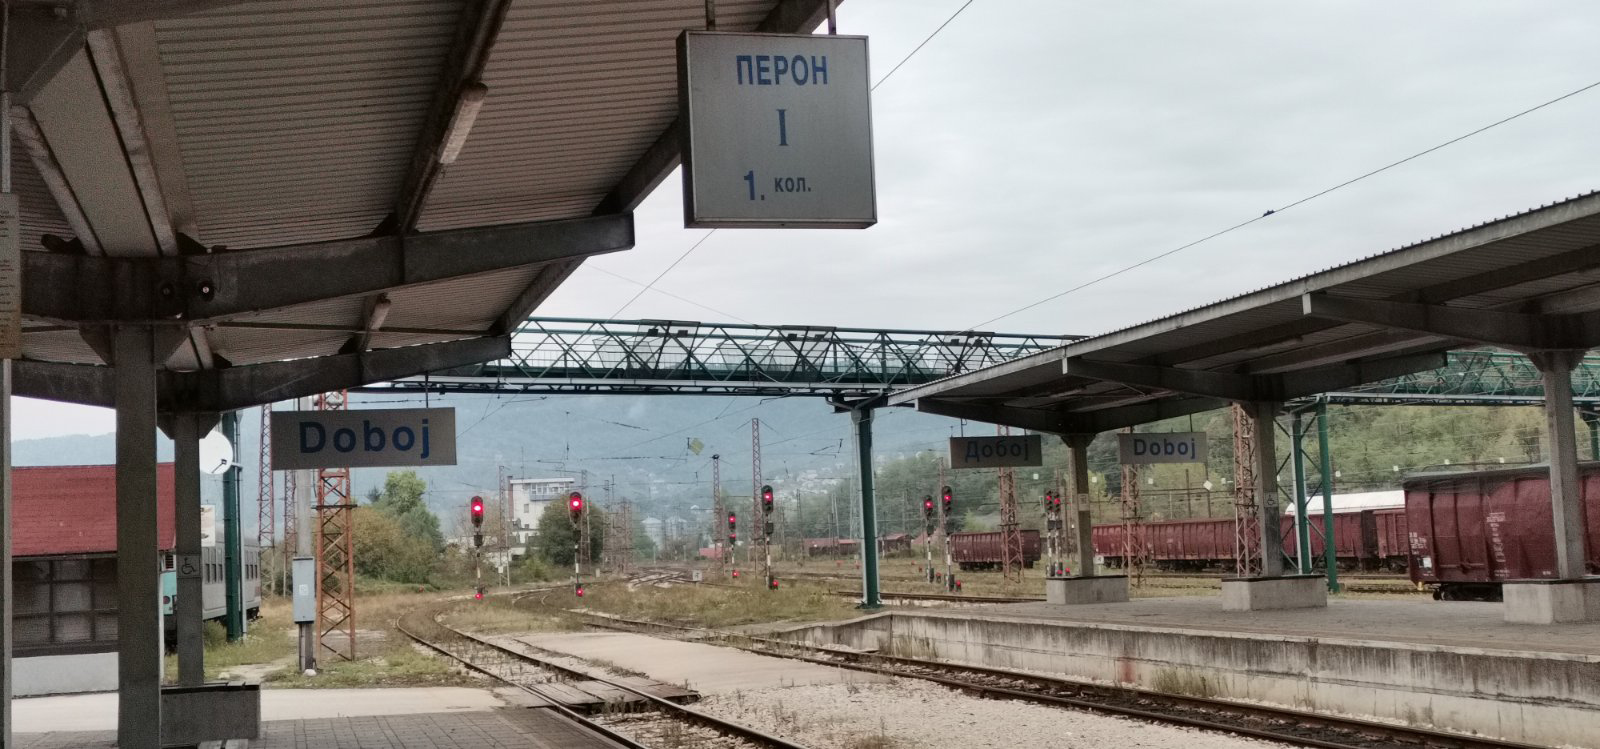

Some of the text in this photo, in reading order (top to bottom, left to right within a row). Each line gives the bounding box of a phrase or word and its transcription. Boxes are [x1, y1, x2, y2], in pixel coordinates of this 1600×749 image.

[735, 54, 828, 86] ПЕРОН
[776, 108, 789, 146] I
[743, 170, 812, 201] 1. кол.
[300, 418, 430, 460] Doboj
[965, 439, 1029, 463] Добој
[1133, 438, 1196, 460] Doboj
